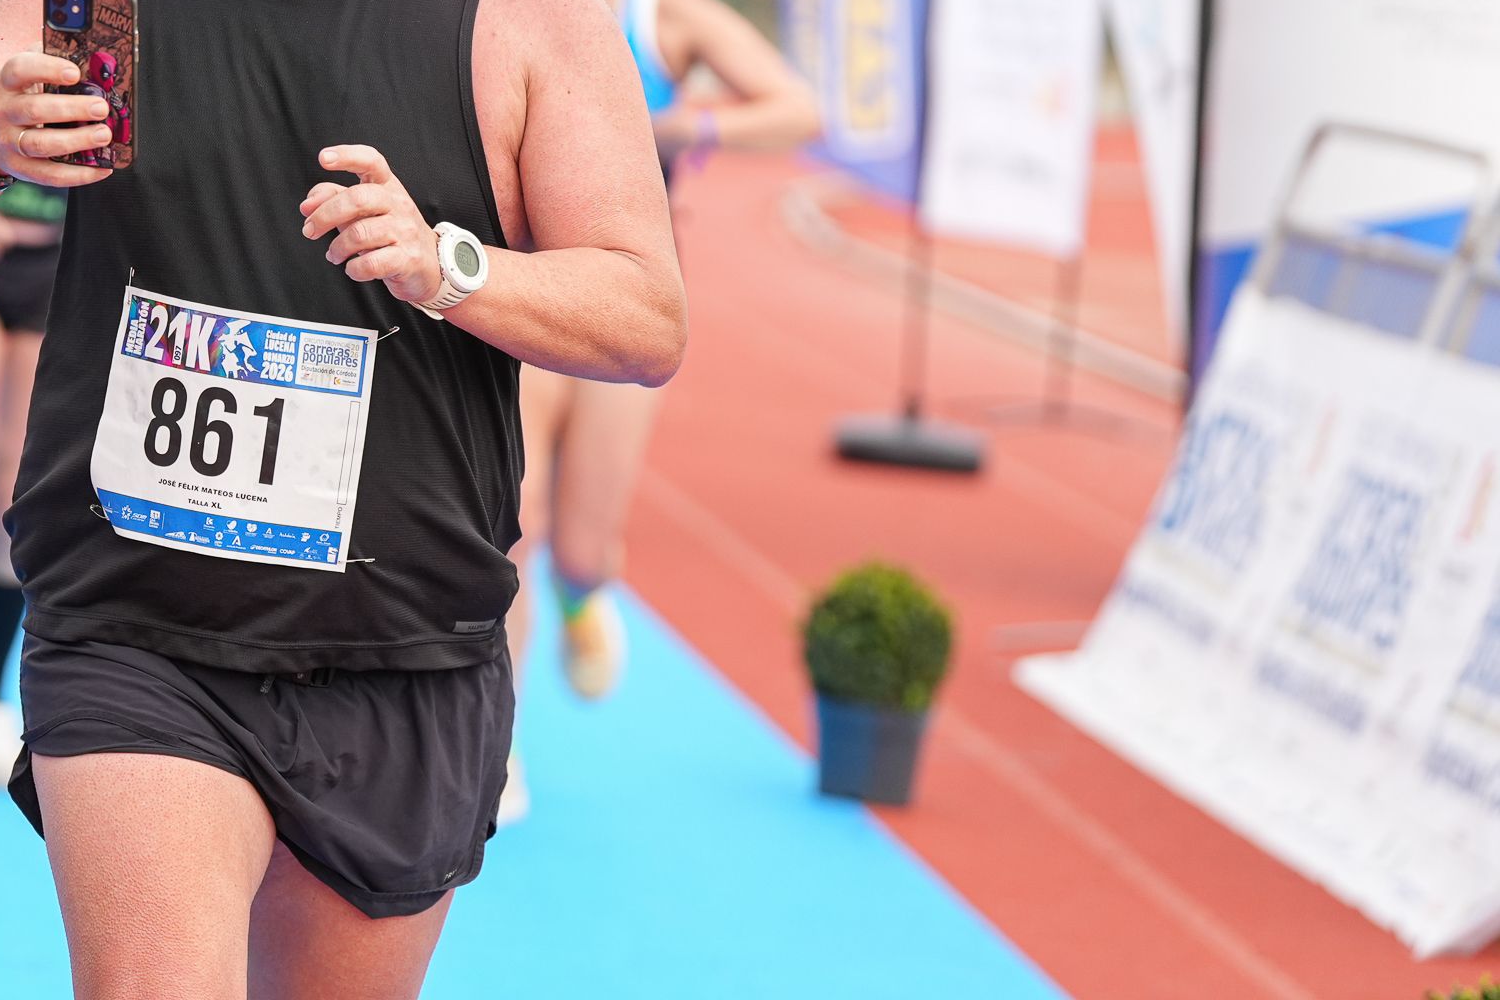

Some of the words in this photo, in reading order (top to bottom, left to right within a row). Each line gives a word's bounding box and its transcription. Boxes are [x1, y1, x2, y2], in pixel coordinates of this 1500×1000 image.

[125, 319, 139, 353] MEDIA
[134, 300, 150, 356] MARATÓN
[144, 304, 217, 371] 21K
[266, 330, 288, 340] Ciudad
[289, 333, 297, 342] de
[265, 338, 295, 353] LUCENA
[303, 343, 350, 358] carreras
[302, 351, 358, 368] populares
[260, 361, 294, 382] 2026
[301, 364, 328, 374] Diputación
[336, 370, 357, 378] Córdoba
[144, 377, 285, 485] 861
[158, 478, 176, 487] JOSÉ
[178, 481, 199, 492] FÉLIX
[201, 486, 234, 498] MATEOS
[235, 492, 268, 503] LUCENA
[188, 498, 209, 507] TALLA
[210, 501, 222, 509] XL
